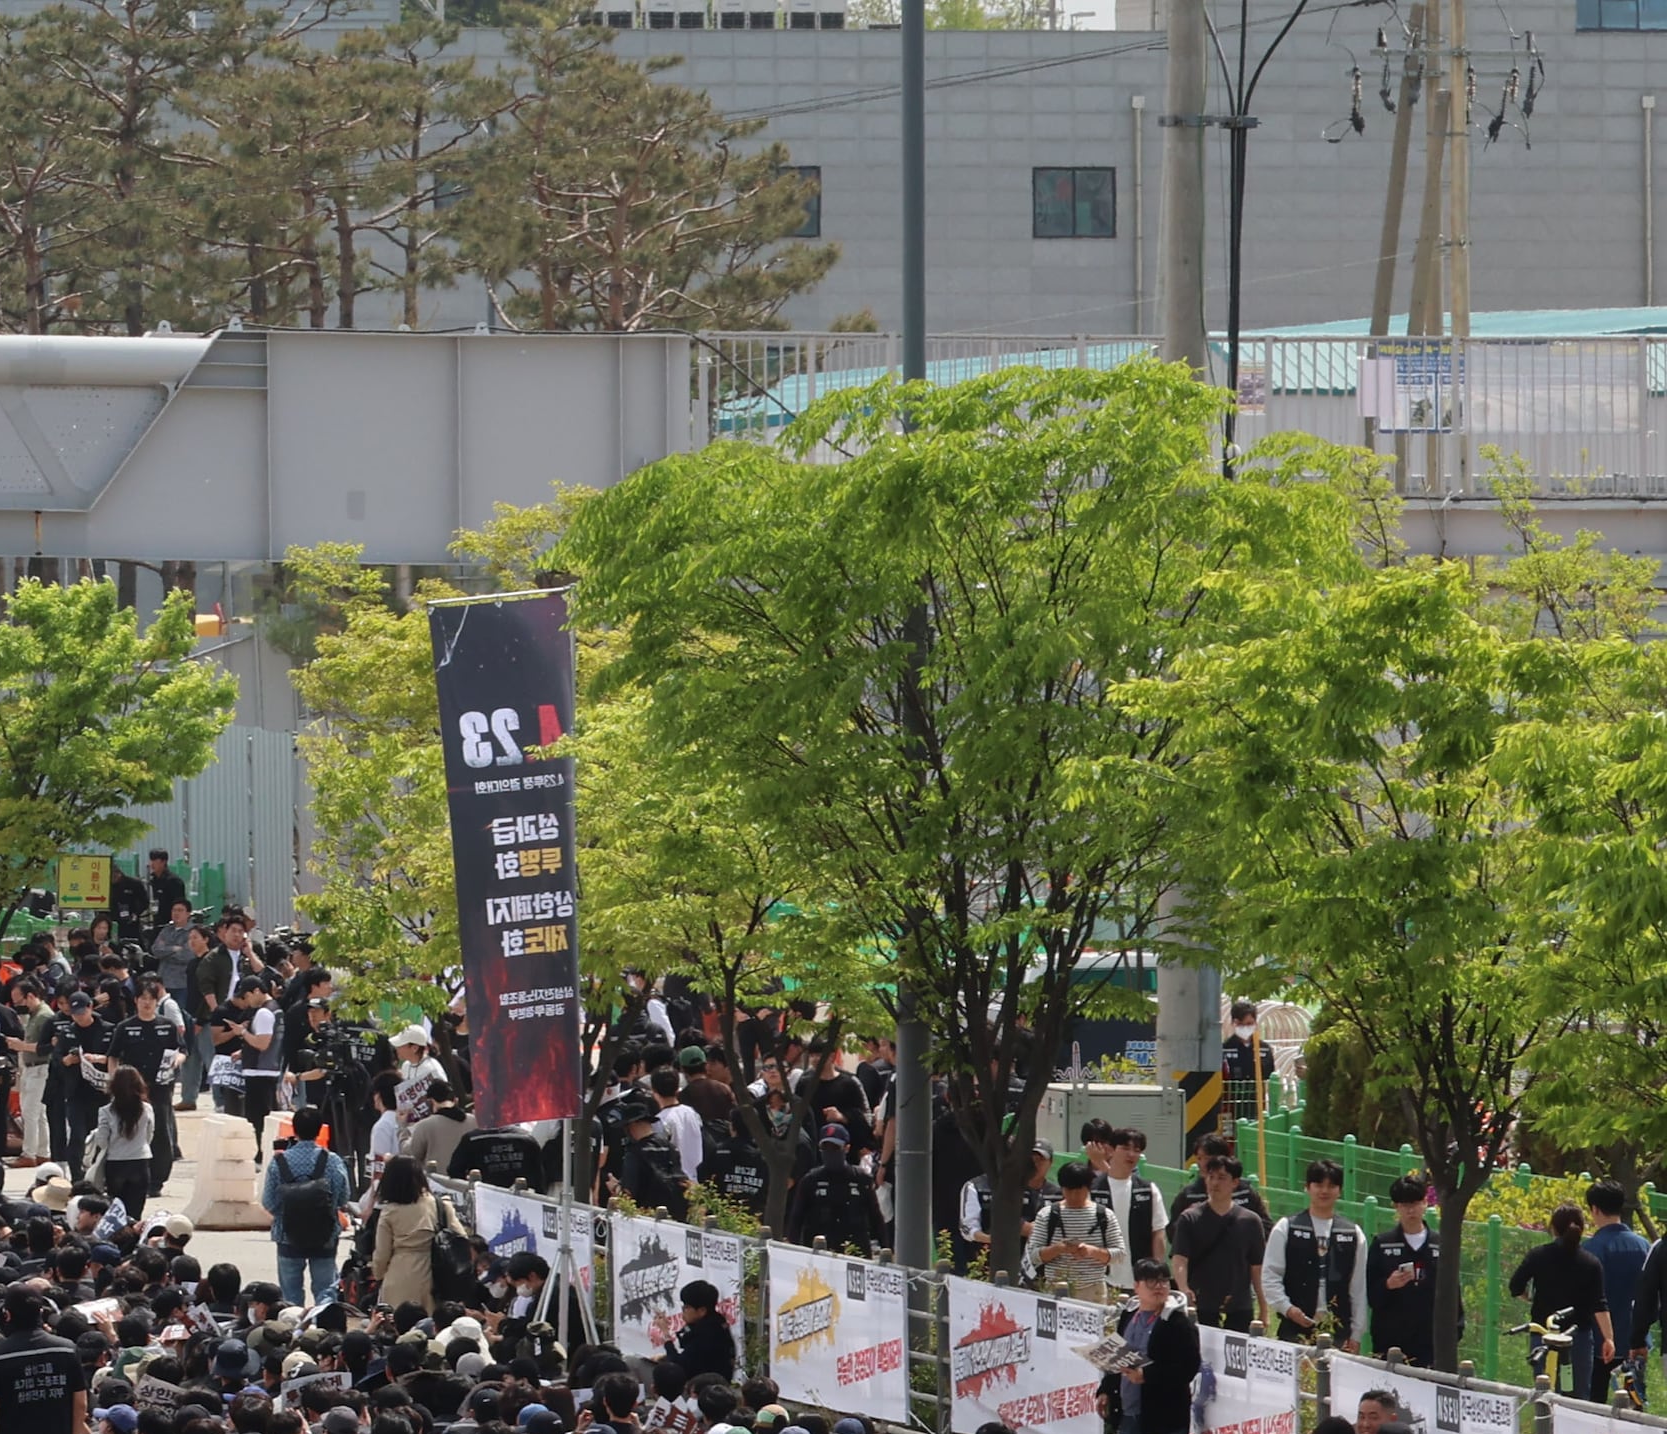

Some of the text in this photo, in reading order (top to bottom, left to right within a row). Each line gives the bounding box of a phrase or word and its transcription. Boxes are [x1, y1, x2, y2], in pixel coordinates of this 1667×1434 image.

[24, 1362, 53, 1375] 삼성그룹
[37, 1375, 67, 1387] 노동조합
[49, 1388, 65, 1399] 지부
